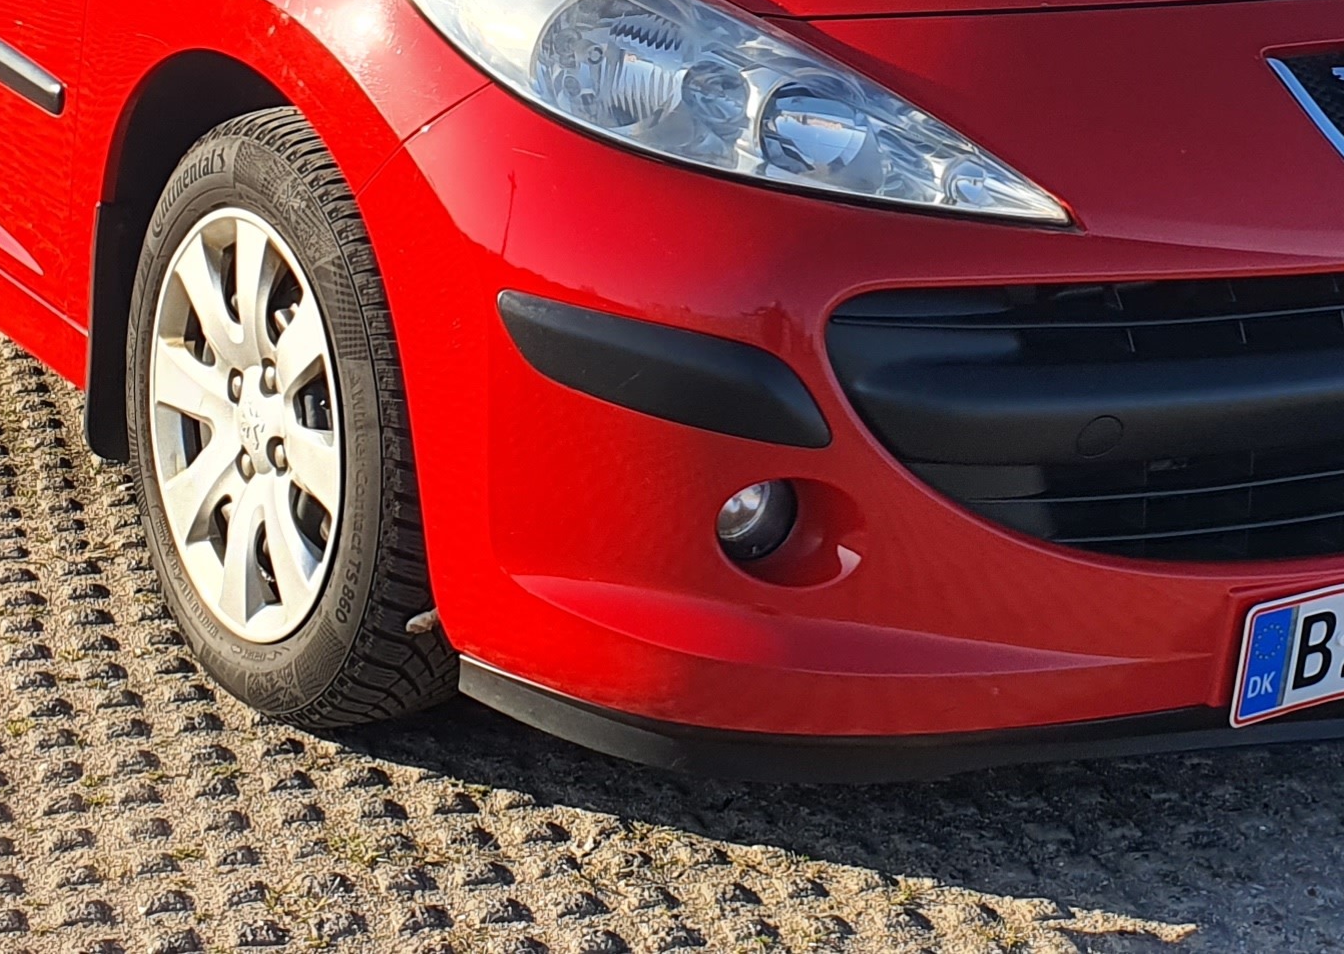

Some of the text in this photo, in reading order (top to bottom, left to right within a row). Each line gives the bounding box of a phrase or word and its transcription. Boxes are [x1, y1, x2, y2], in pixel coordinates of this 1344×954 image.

[151, 148, 216, 238] Continental
[345, 558, 362, 586] TS
[335, 584, 355, 624] 860
[1246, 671, 1274, 699] DK
